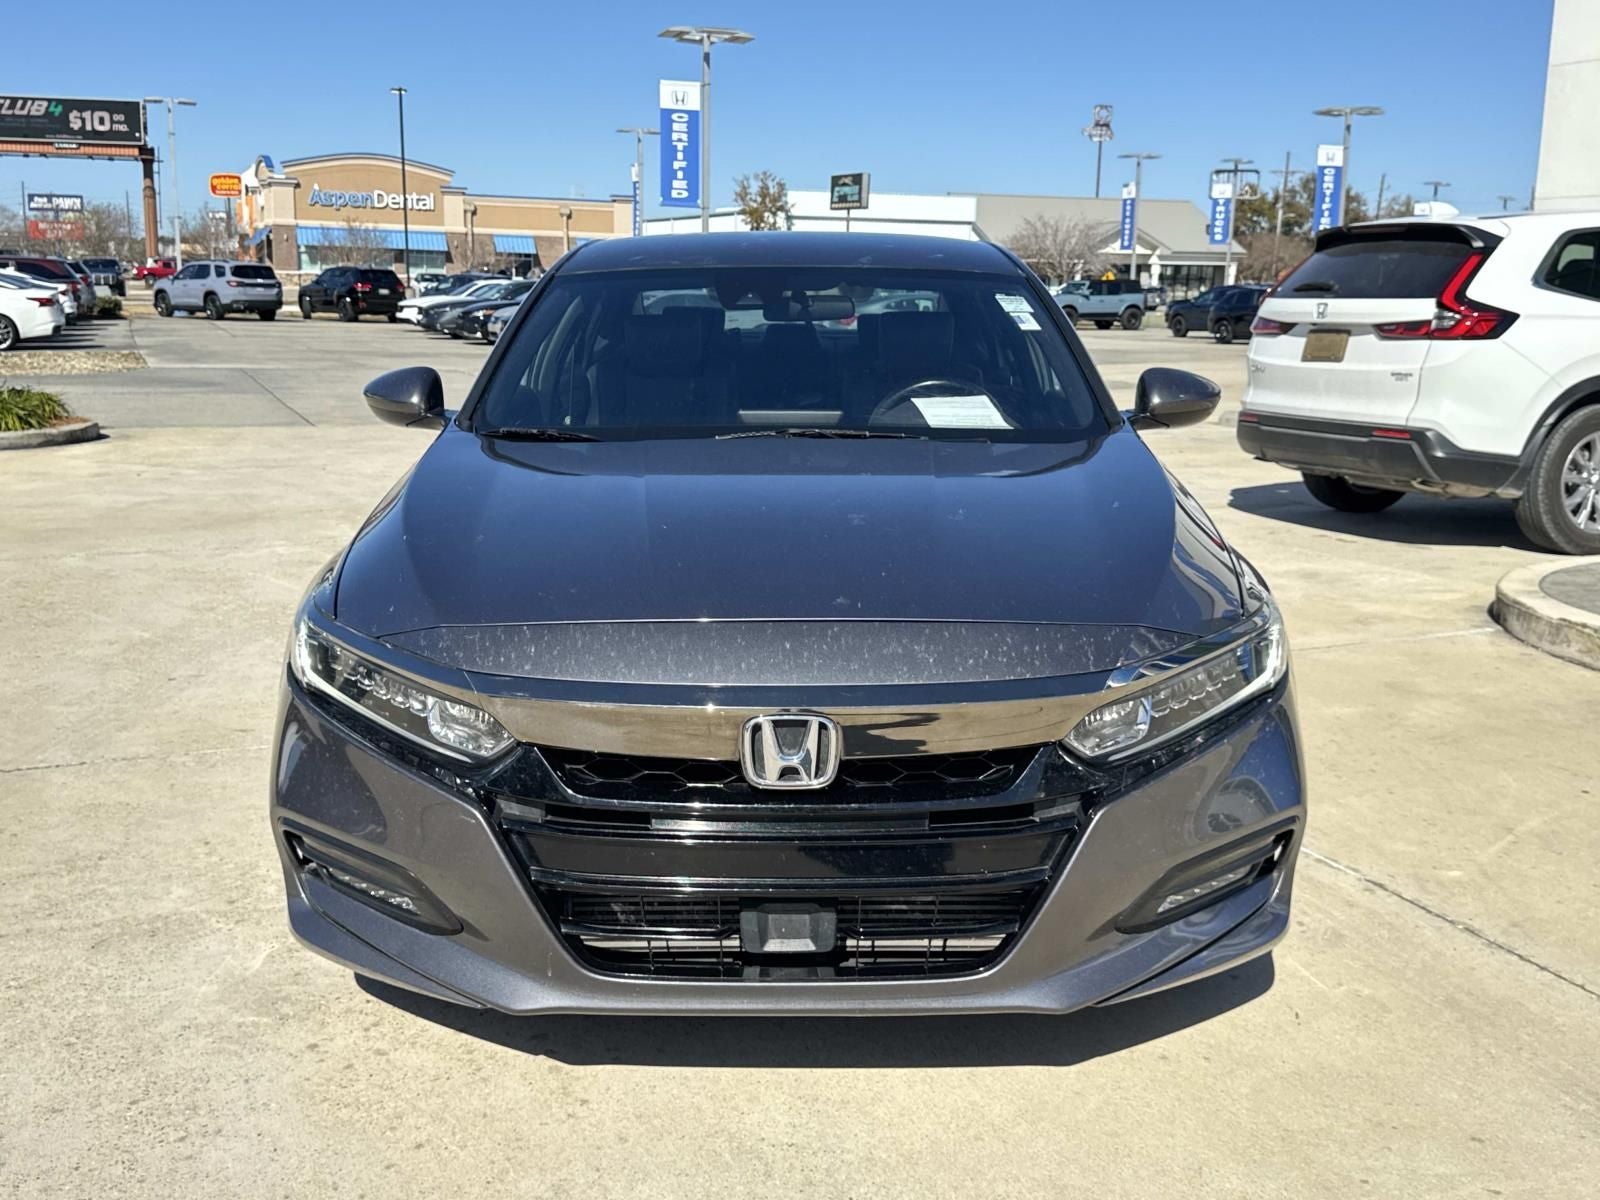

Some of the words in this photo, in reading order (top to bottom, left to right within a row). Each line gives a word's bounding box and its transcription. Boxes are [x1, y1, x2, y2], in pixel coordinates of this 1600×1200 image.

[0, 99, 63, 116] LUB4
[68, 109, 111, 131] $10
[671, 112, 689, 199] CERTIFIED
